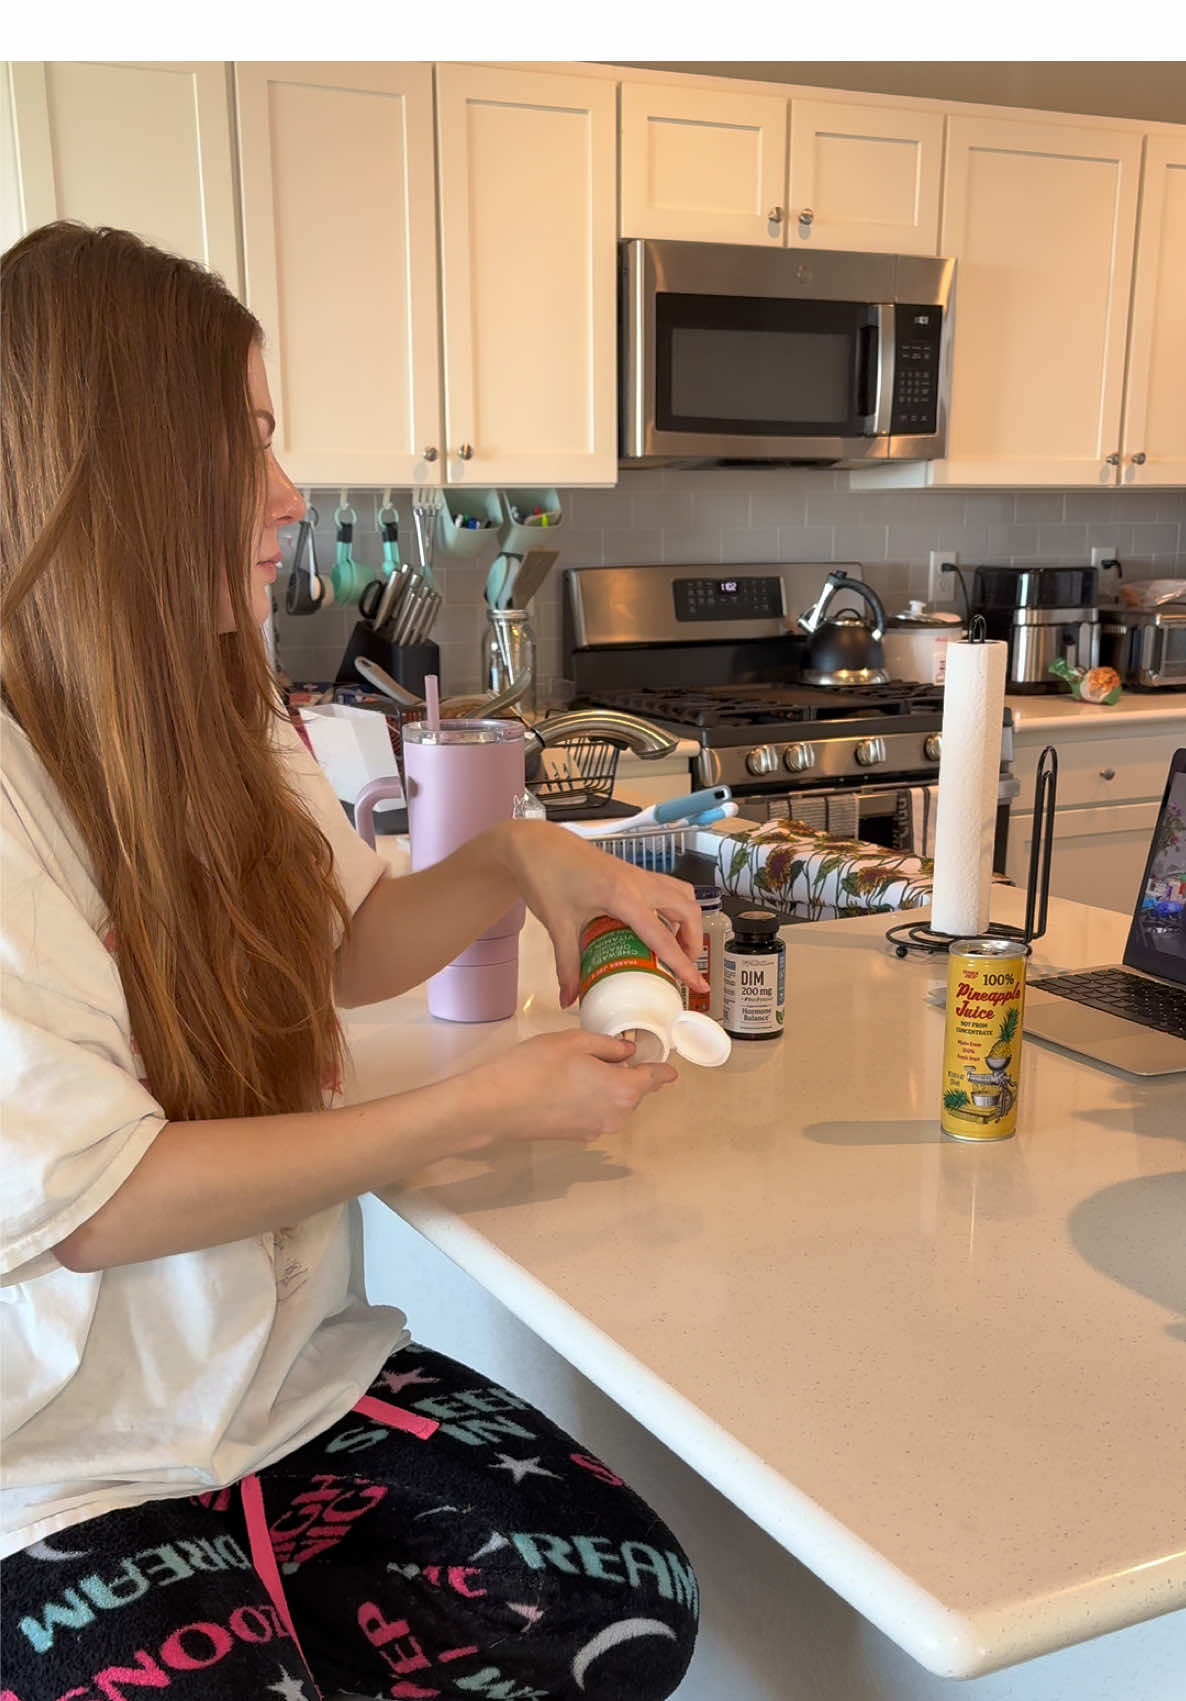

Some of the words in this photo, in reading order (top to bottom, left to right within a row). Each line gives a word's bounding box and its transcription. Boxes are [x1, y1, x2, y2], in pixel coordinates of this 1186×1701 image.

[741, 970, 765, 986] DIM
[983, 973, 1015, 986] 100%
[741, 986, 758, 996] 200
[759, 987, 773, 997] mg
[956, 982, 1021, 1006] Pineapple
[956, 1000, 995, 1019] Juice
[19, 1533, 252, 1653] DREAM
